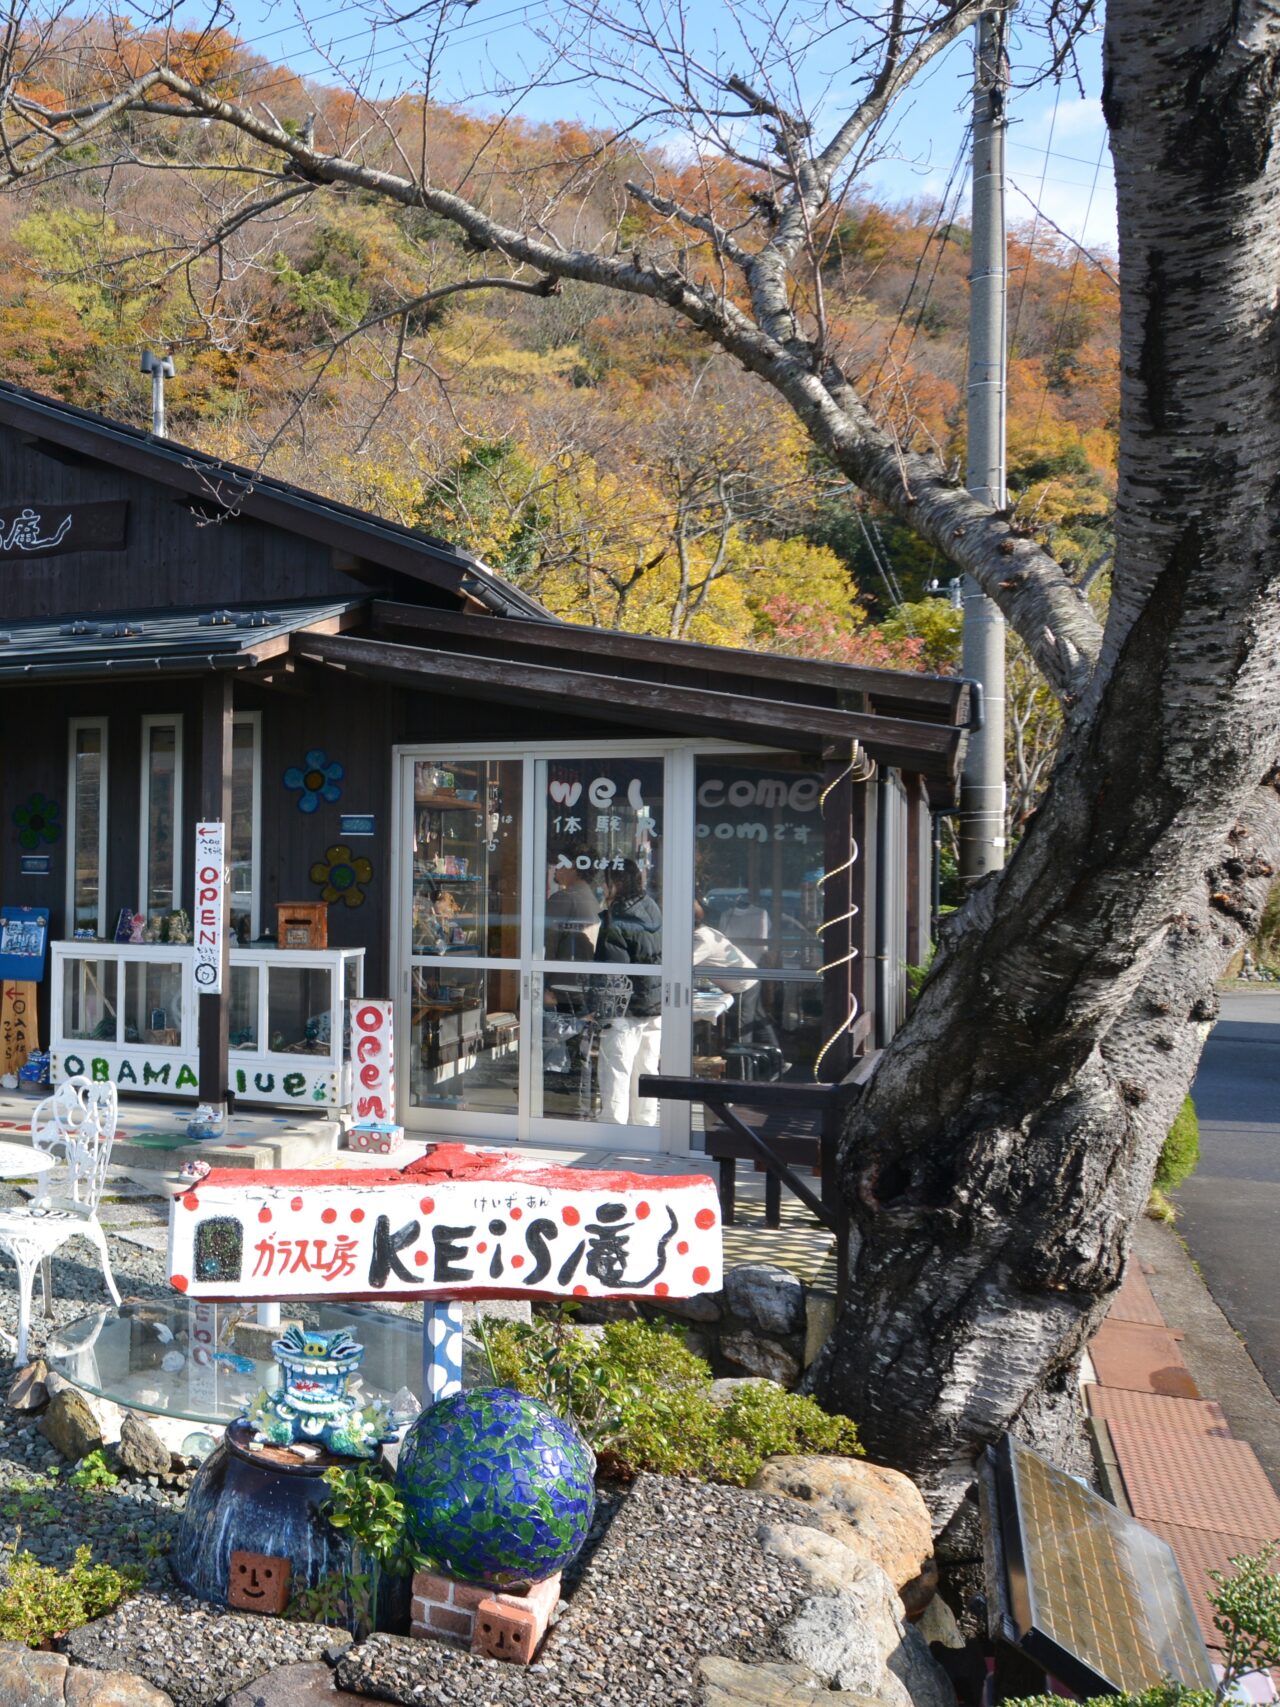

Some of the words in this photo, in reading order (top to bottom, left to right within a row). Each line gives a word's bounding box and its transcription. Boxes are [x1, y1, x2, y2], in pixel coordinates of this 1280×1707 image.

[199, 866, 219, 945] OPEN
[64, 1054, 199, 1089] OBAMA
[251, 1231, 359, 1282] ガラス工房
